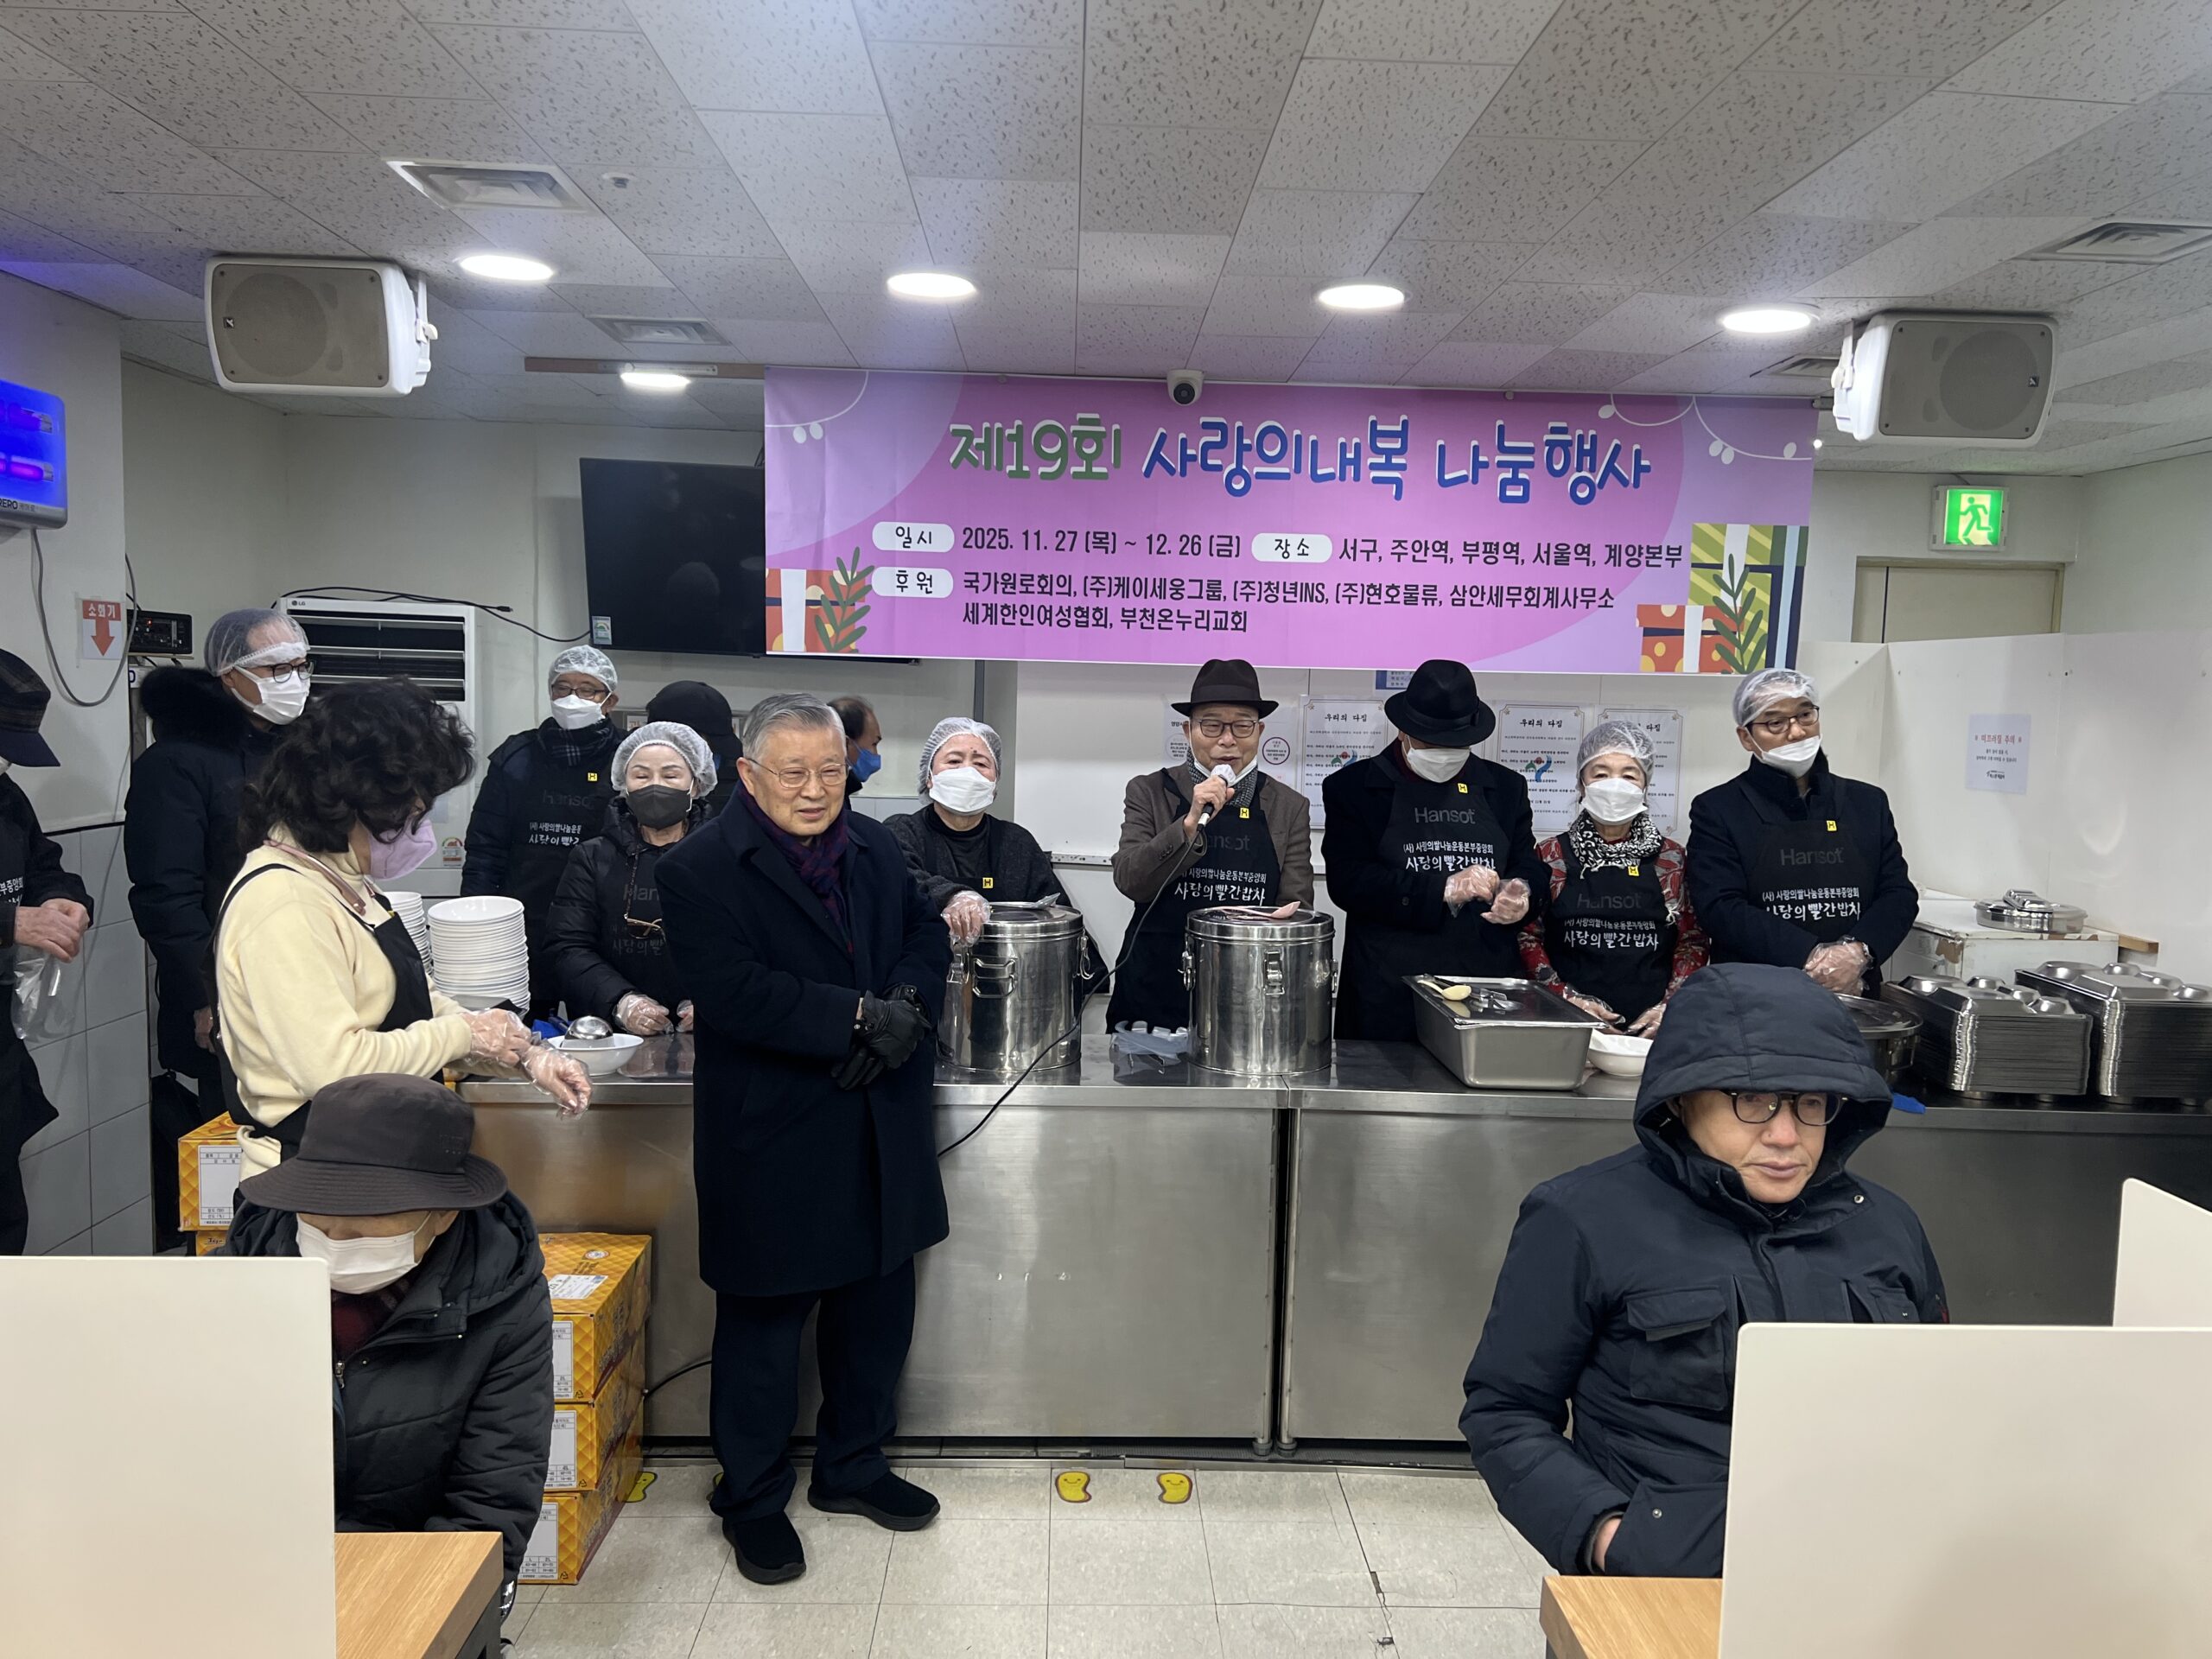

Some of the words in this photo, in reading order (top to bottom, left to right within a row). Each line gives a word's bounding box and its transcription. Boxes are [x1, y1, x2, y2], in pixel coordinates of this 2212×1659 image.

[950, 413, 1122, 480] 제19회
[1142, 414, 1409, 501] 사랑의내복
[1436, 419, 1652, 505] 나눔행사
[963, 527, 1014, 550] 2025.
[1022, 529, 1048, 551] 11.
[1146, 533, 1172, 556] 12.
[1338, 538, 1382, 563] 서구,
[1390, 539, 1454, 564] 주안역,
[1462, 541, 1525, 566] 부평역,
[1532, 542, 1597, 567] 서울역,
[1604, 543, 1683, 569] 계양본부
[963, 571, 1077, 598] 국가원로회의,
[1450, 585, 1615, 609] 삼안세무회계사무소
[88, 603, 116, 619] 소화기
[963, 602, 1113, 629] 세계한인여성협회,
[1120, 607, 1248, 632] 부천온누리교회
[1325, 714, 1348, 723] 우리의
[1520, 719, 1542, 728] 우리의
[1414, 807, 1476, 824] Hansot
[623, 885, 659, 901] Han
[1577, 893, 1642, 909] Hansot
